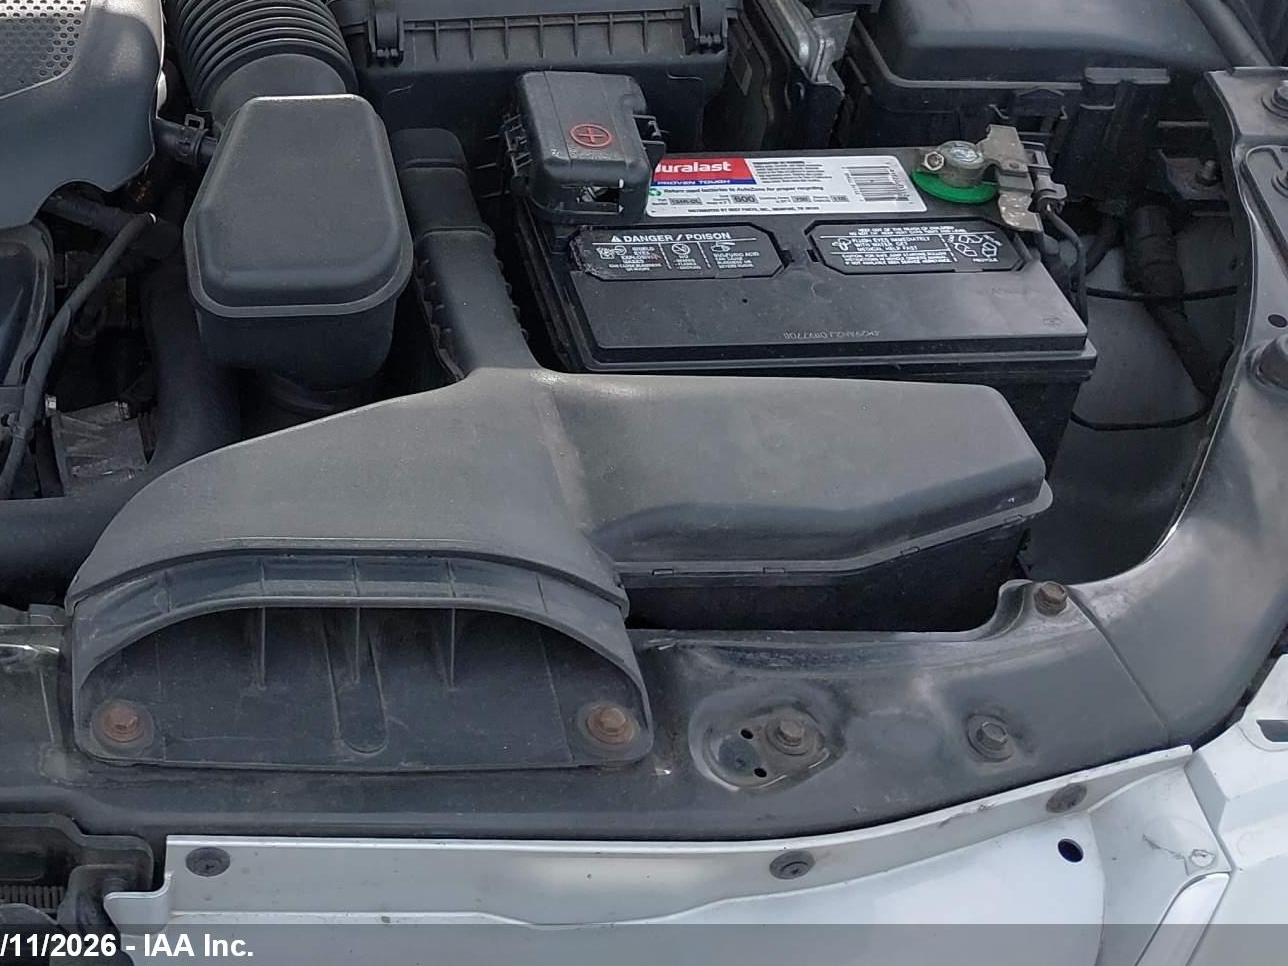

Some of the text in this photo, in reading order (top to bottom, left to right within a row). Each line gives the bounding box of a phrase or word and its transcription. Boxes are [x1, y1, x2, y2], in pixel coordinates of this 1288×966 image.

[734, 195, 755, 204] 600
[622, 234, 673, 242] DANGER
[685, 232, 731, 240] POISON
